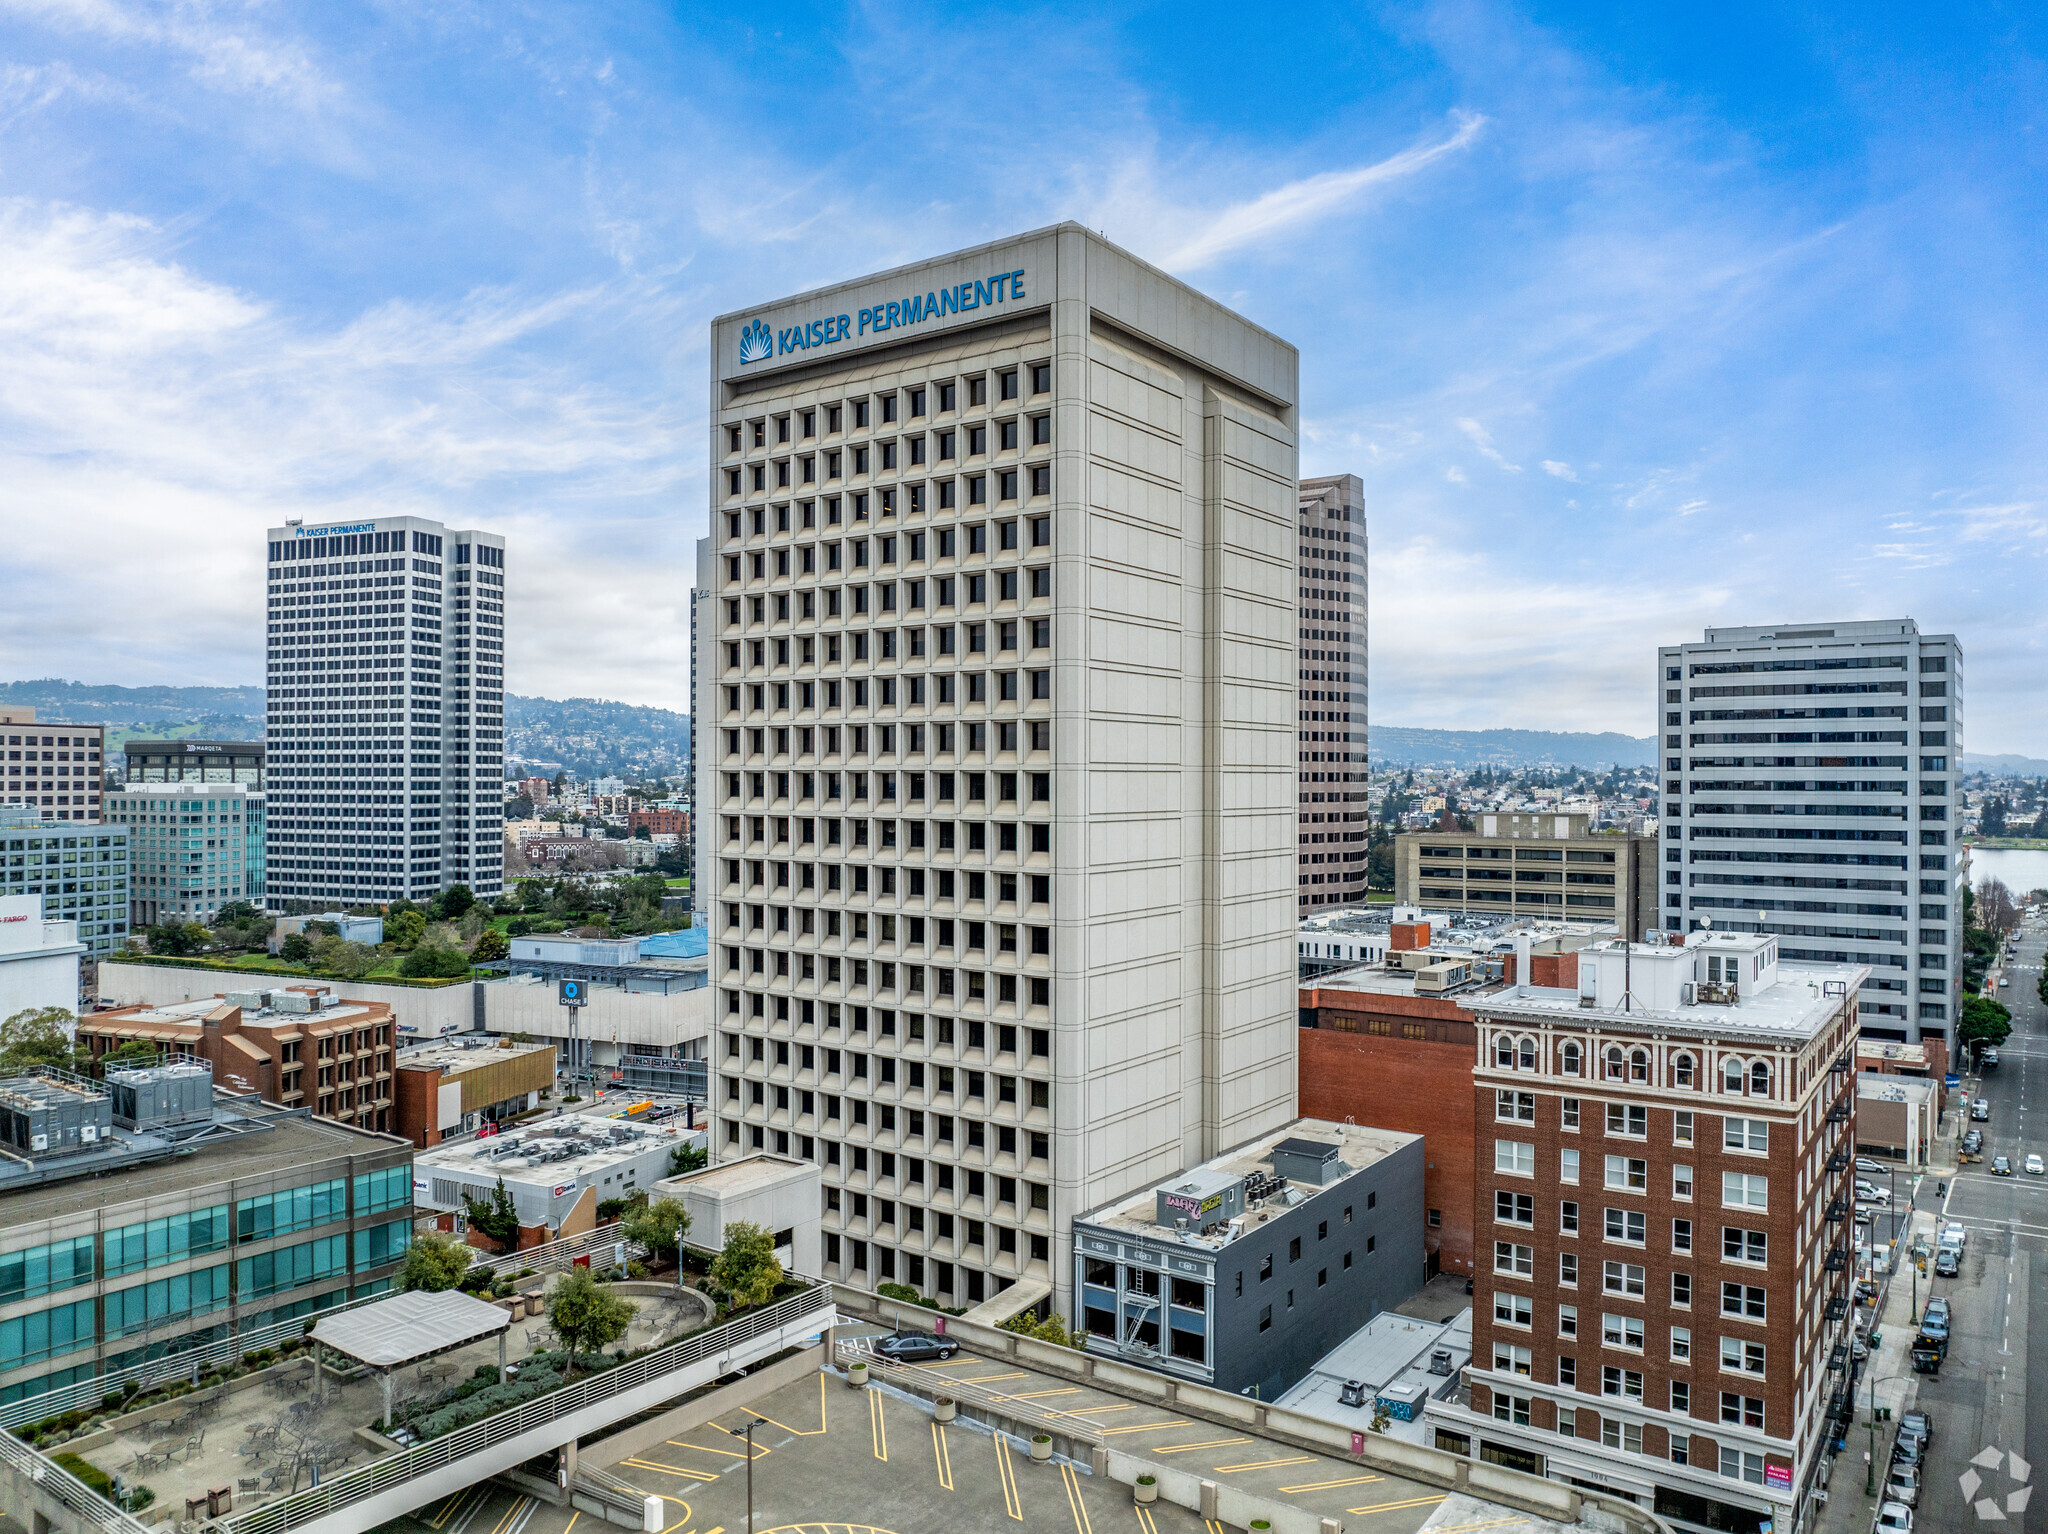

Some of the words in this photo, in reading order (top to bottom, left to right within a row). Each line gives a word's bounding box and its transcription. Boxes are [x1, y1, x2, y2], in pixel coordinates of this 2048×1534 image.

[778, 313, 850, 355] KAISER
[858, 269, 1025, 335] PERMANENTE
[306, 527, 329, 537] KAISER
[330, 523, 376, 535] PERMANENTE
[3, 914, 28, 923] FARGO
[560, 997, 582, 1006] CHASE
[1767, 1472, 1789, 1480] AVAILABLE
